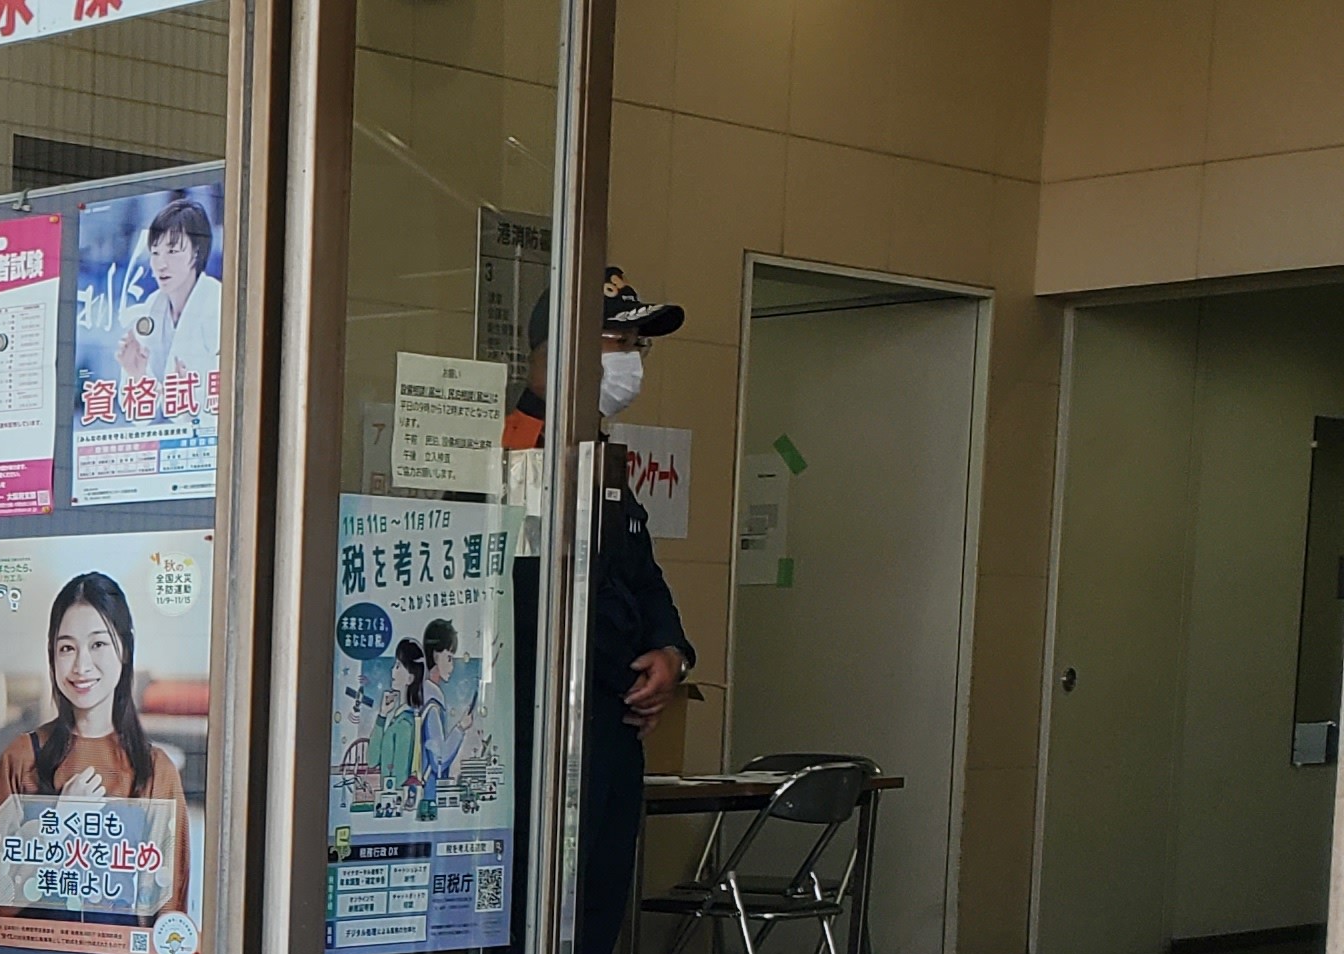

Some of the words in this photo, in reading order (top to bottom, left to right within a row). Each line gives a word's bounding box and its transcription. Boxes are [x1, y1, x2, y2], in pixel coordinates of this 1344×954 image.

[164, 559, 184, 572] 秋の
[341, 531, 508, 595] 税を考える週間
[156, 573, 192, 583] 全国火災
[156, 584, 192, 595] 予防運動
[40, 809, 123, 837] 急ぐ日も
[2, 838, 162, 871] 足止め火を止め
[37, 869, 121, 898] 準備よし
[433, 873, 474, 894] 国税庁
